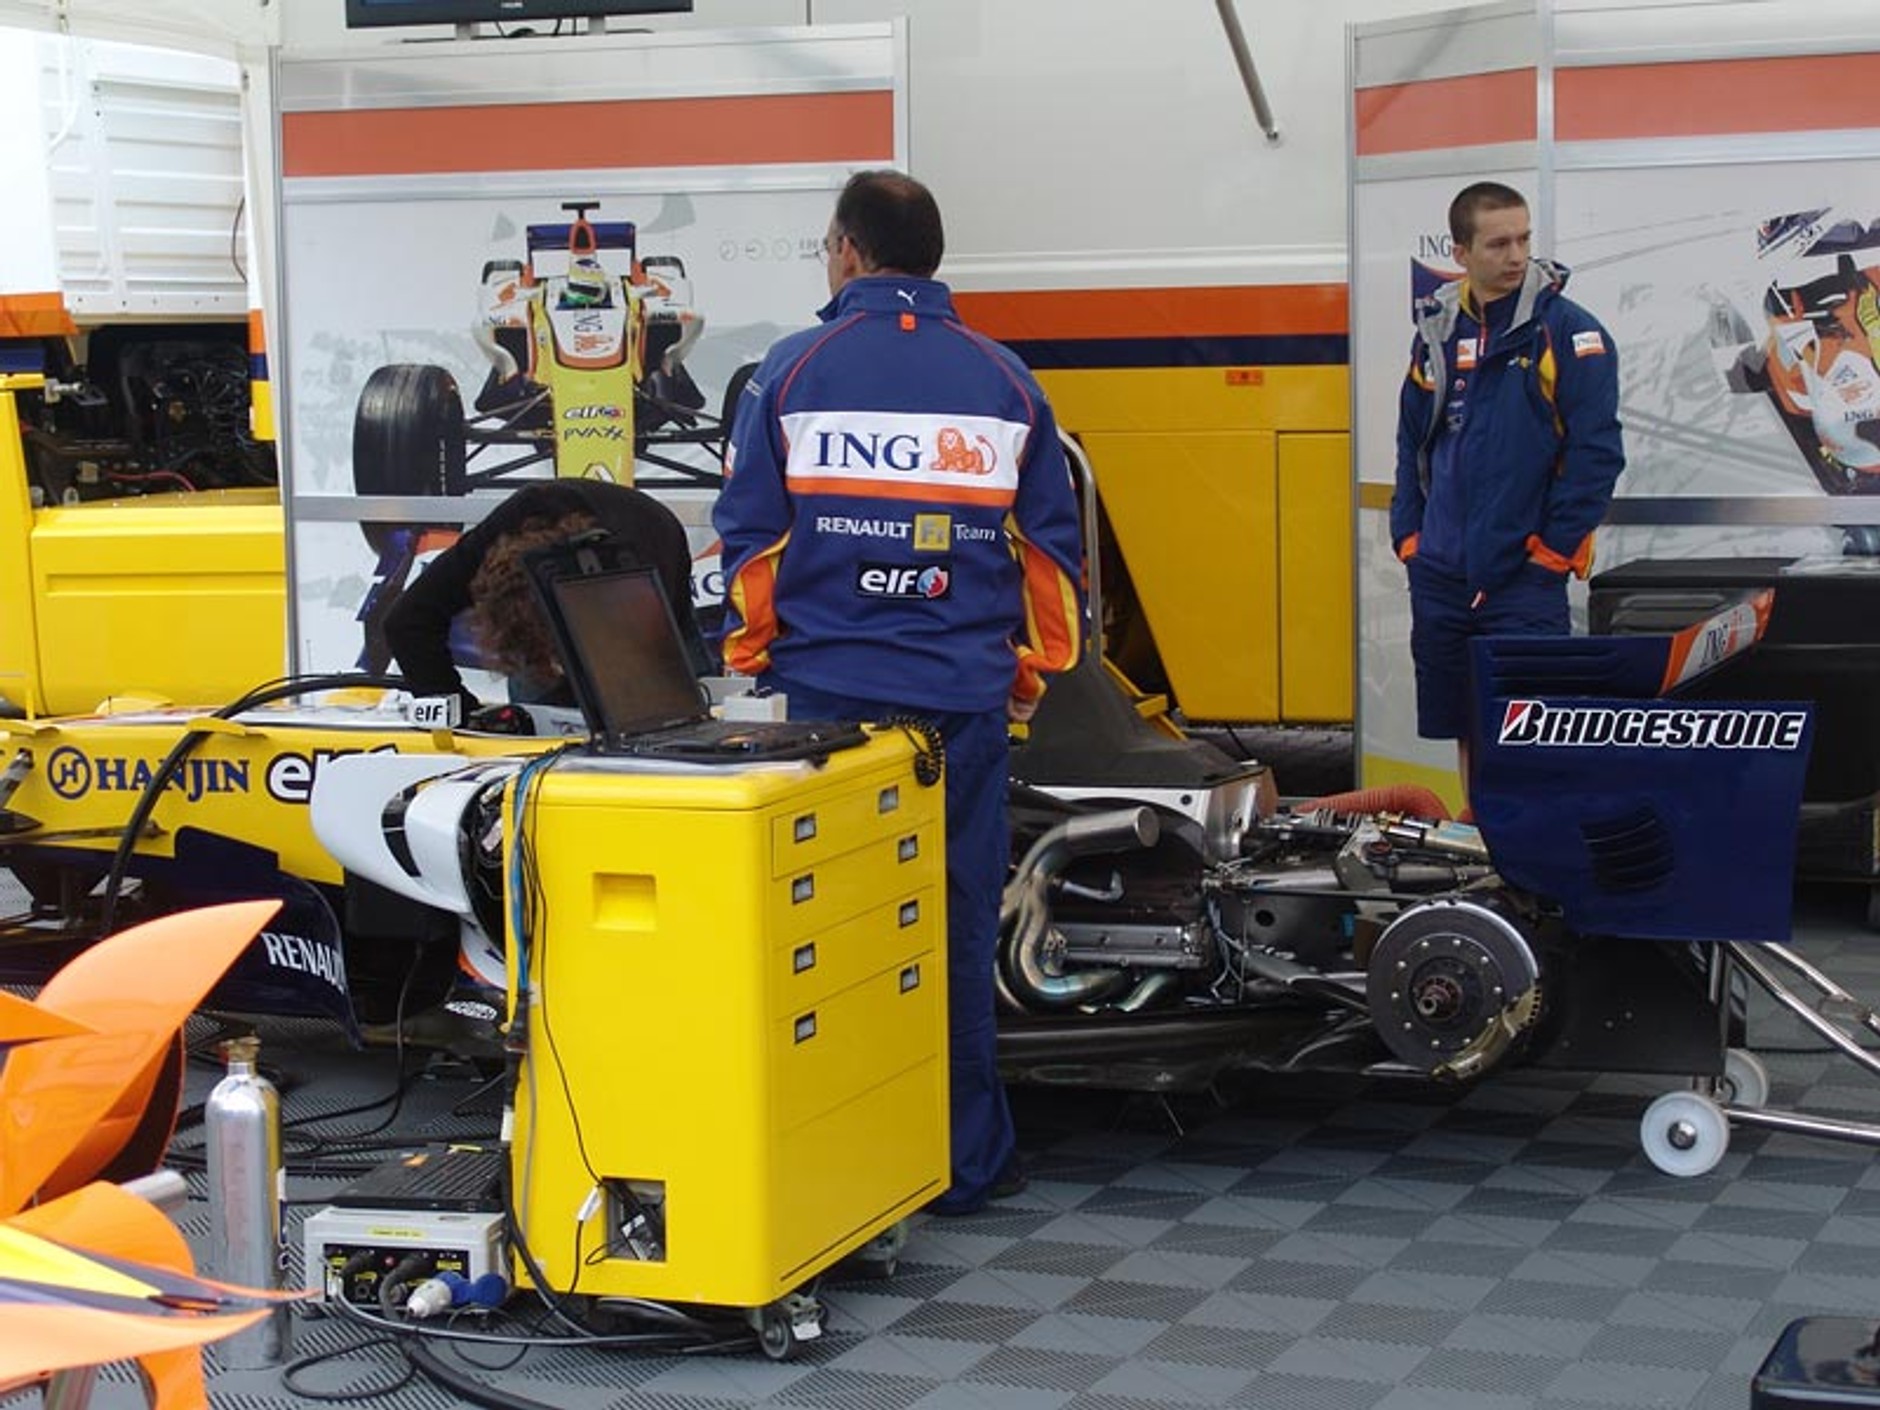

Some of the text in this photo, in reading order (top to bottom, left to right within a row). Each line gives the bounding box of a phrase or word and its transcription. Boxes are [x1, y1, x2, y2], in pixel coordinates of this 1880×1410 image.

[1419, 234, 1451, 258] ING
[814, 431, 923, 472] ING
[815, 516, 912, 540] RENAULT
[953, 522, 996, 542] Team
[860, 568, 918, 594] elf
[1500, 701, 1804, 749] BRIDGESTONE
